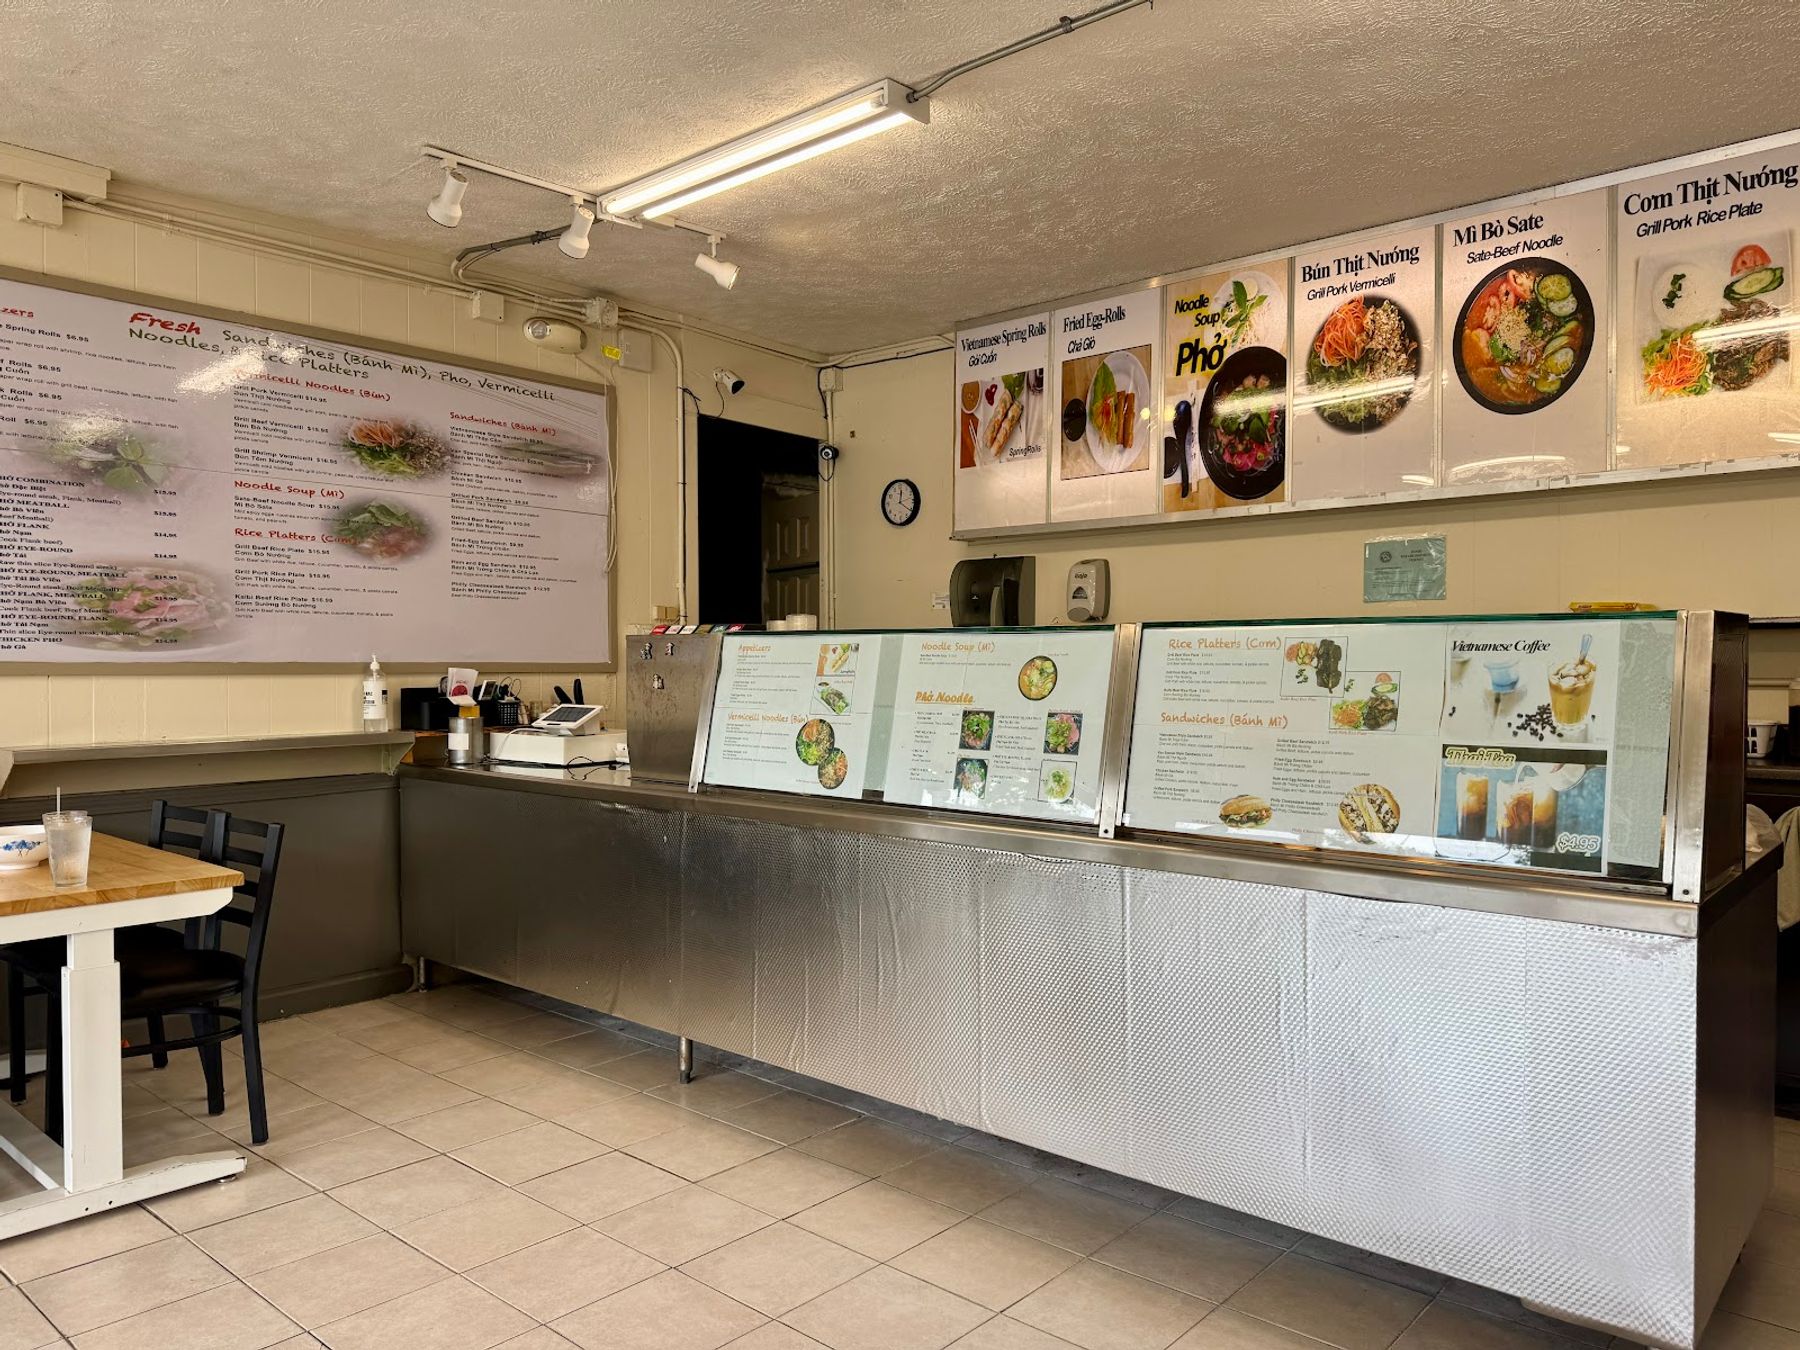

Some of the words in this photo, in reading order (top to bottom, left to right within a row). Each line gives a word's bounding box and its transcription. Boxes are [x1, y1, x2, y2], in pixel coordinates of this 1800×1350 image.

[1624, 192, 1672, 215] Cơm
[1677, 177, 1720, 204] Thịt
[1723, 165, 1799, 195] Nướng
[1637, 220, 1662, 237] Grill
[1663, 214, 1693, 232] Pork
[1697, 210, 1727, 225] Rice
[1729, 202, 1763, 219] Plate
[1453, 225, 1477, 247] Mì
[1480, 220, 1504, 242] Bò
[1508, 213, 1544, 235] Sate
[1467, 242, 1521, 264] Sate-Beef
[1522, 234, 1563, 253] Noodle
[1301, 263, 1330, 283] Bún
[1334, 255, 1364, 276] Thịt
[1366, 246, 1420, 269] Nướng
[1308, 287, 1326, 300] Grill
[1326, 283, 1348, 297] Pork
[1350, 273, 1396, 292] Vermicelli
[1174, 294, 1210, 314] Noodle
[1063, 314, 1084, 332] Fried
[1087, 306, 1126, 330] Egg-Rolls
[1194, 312, 1220, 327] Soup
[5, 324, 36, 334] Spring
[38, 329, 60, 338] Rolls
[67, 334, 89, 342] $6.95
[961, 335, 1001, 352] Vietnamese
[1002, 328, 1027, 346] Spring
[1028, 322, 1046, 337] Rolls
[129, 328, 224, 354] Noodles,
[299, 358, 369, 379] Platters
[129, 312, 200, 334] Fresh
[223, 330, 334, 360] Sandihes
[344, 352, 392, 370] (Bánh
[402, 365, 431, 380] Mì),
[440, 372, 472, 387] Pho,
[478, 378, 555, 400] Vermicelli
[1176, 332, 1228, 377] Phở
[9, 360, 32, 368] Rolls
[38, 364, 61, 372] $6.95
[236, 368, 300, 385] Vmicelli
[306, 381, 354, 395] Noodles
[360, 389, 390, 401] (Bún)
[10, 388, 33, 396] Rolls
[39, 392, 62, 400] $6.95
[269, 389, 303, 399] Vermicelli
[269, 421, 303, 429] Vermicelli
[450, 412, 507, 426] Sandwiches
[279, 453, 312, 461] Vermicelli
[16, 477, 85, 487] COMBINATION
[234, 481, 282, 492] Noodle
[287, 486, 316, 498] Soup
[321, 488, 344, 499] (Mì)
[16, 500, 70, 508] MEATBALL
[235, 528, 262, 537] Rice
[269, 530, 316, 541] Platters
[18, 568, 75, 576] EYE-ROUND,
[738, 644, 771, 654] Appetizers
[922, 641, 951, 651] Noodle
[955, 642, 975, 654] Soup
[978, 641, 995, 653] (Mì)
[1169, 638, 1193, 649] Rice
[1197, 638, 1241, 649] Platters
[1246, 636, 1281, 650] (Cơm)
[1452, 640, 1513, 652] Vietnamese
[1514, 640, 1550, 654] Coffee
[936, 691, 973, 703] Noodle
[728, 712, 759, 720] Vermicelli
[762, 713, 788, 722] Noodles
[791, 714, 808, 724] (Bún)
[1161, 712, 1225, 724] Sandwiches
[1230, 713, 1263, 726] (Bánh
[1269, 715, 1288, 728] Mì)
[1447, 749, 1483, 765] Thai
[1559, 835, 1598, 852] $4.95
